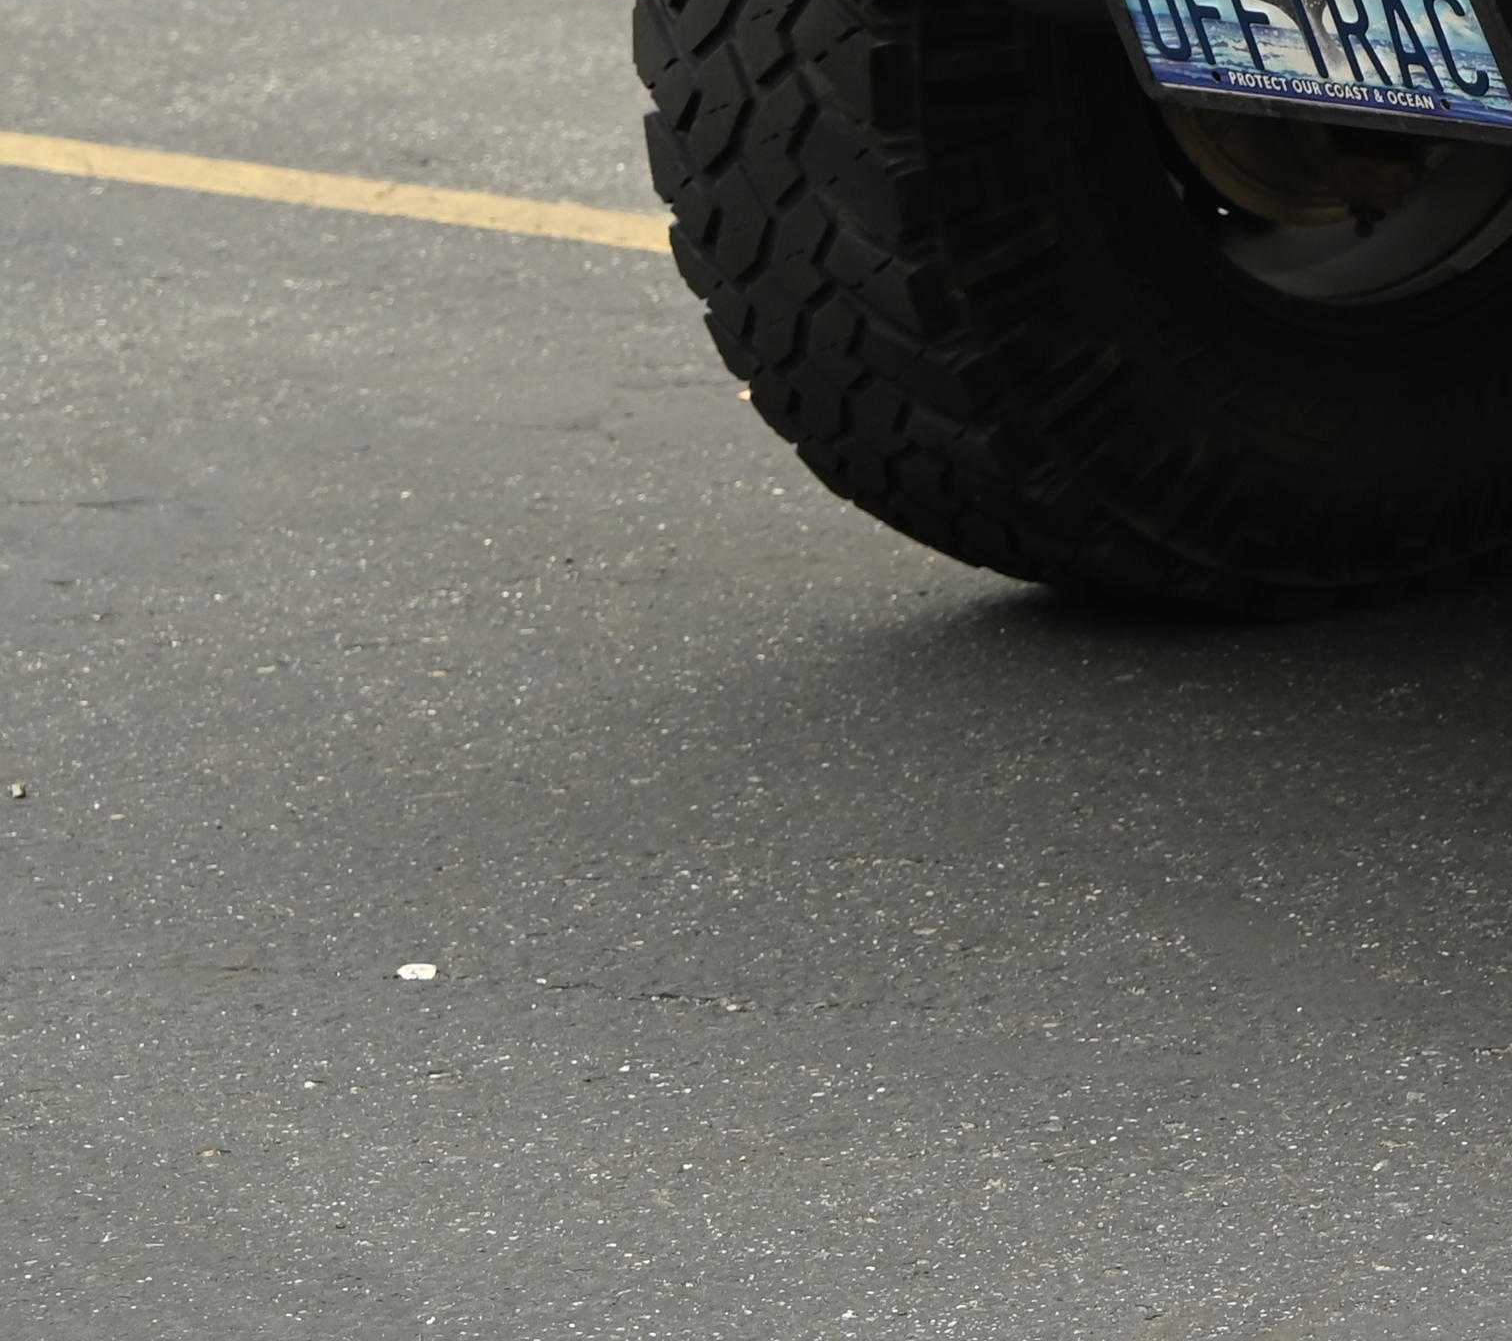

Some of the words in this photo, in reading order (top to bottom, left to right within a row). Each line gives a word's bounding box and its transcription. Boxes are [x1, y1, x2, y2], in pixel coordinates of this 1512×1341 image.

[1228, 71, 1288, 92] PROTECT
[1291, 79, 1322, 96] OUR
[1325, 83, 1370, 102] COAST
[1373, 89, 1384, 103] &
[1387, 91, 1434, 110] OCEAN
